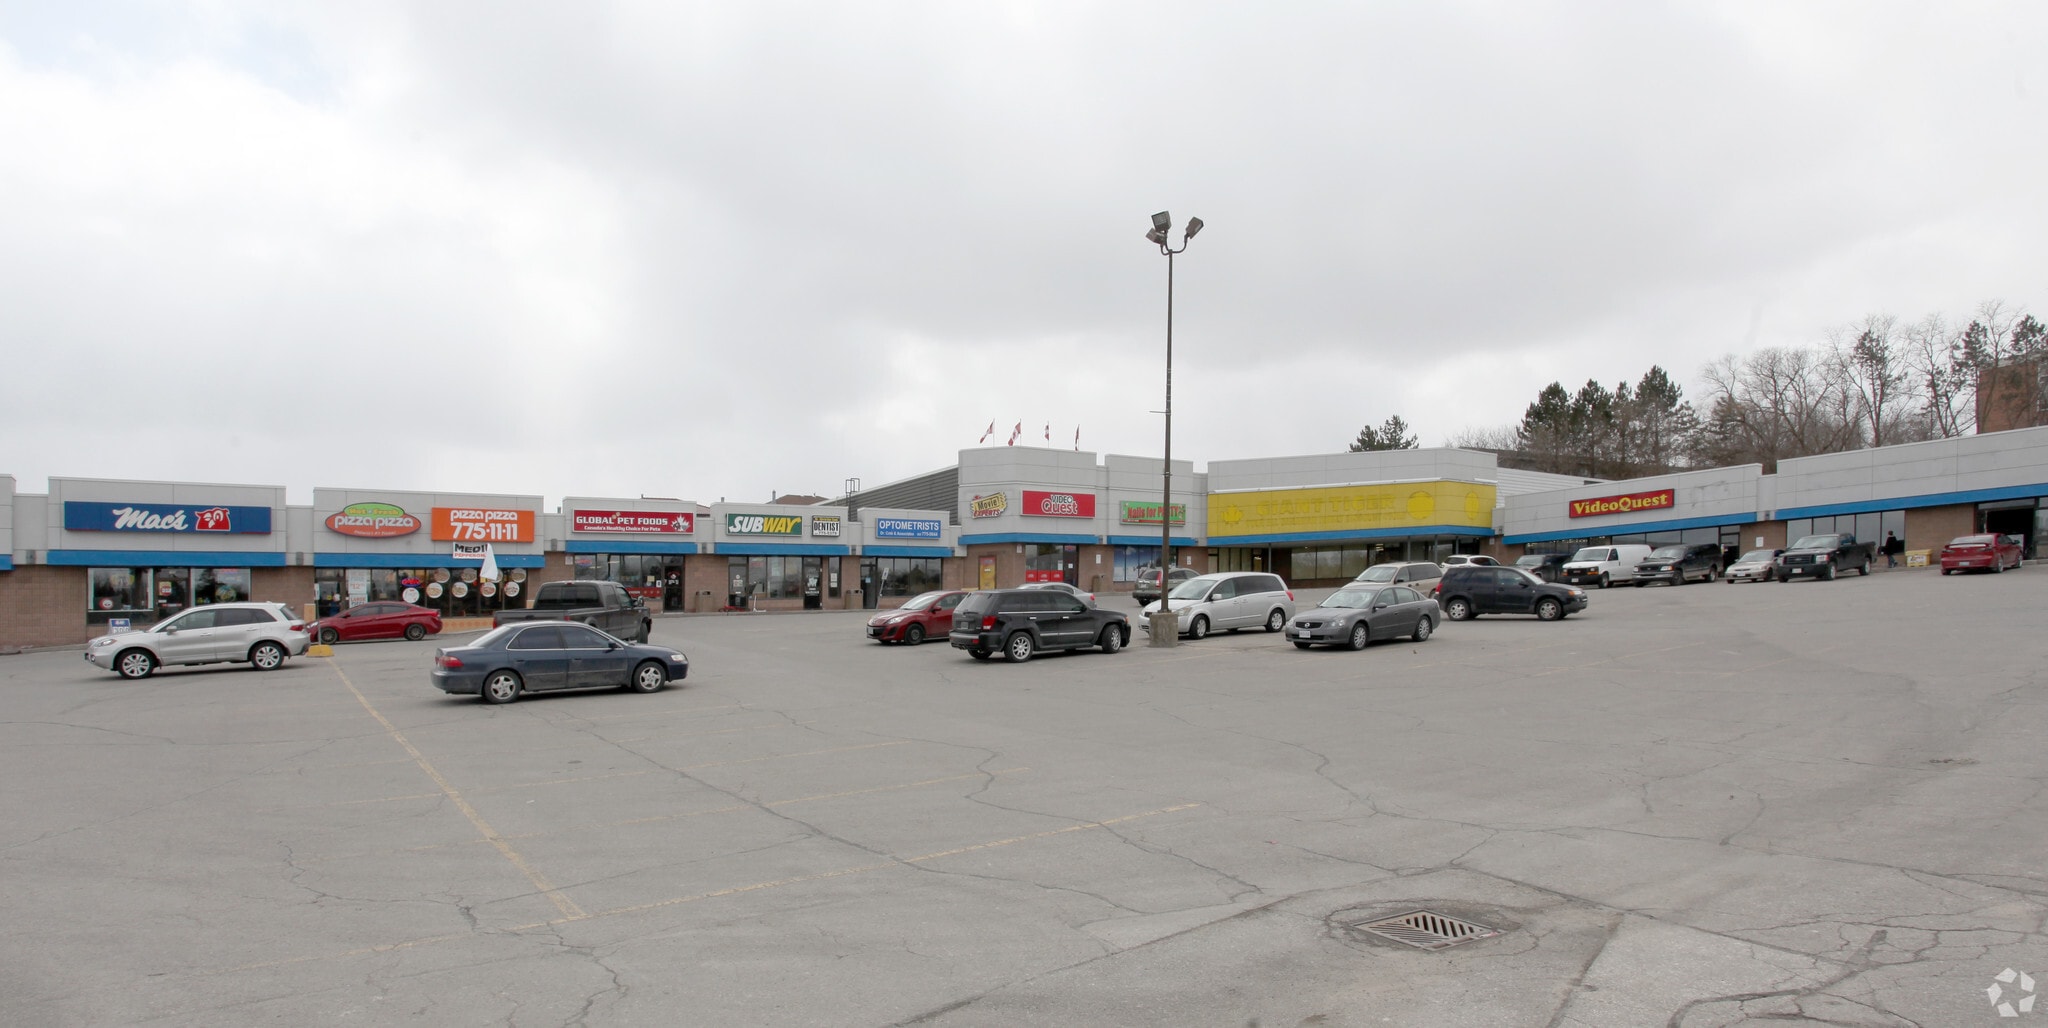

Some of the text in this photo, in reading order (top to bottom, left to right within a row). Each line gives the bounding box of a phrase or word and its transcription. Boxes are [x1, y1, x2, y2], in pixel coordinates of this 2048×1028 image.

[977, 496, 998, 511] Movie
[1041, 498, 1078, 514] Quest
[1051, 494, 1073, 504] VIDEO
[1573, 494, 1668, 514] VideoQuest
[450, 510, 518, 523] pizza pizza
[1127, 504, 1179, 518] Nails for PTY
[112, 507, 188, 530] Mac's
[334, 515, 414, 530] pizza pizza
[576, 516, 668, 526] GLOBAL PET FOODS
[728, 516, 802, 533] SUBWAY
[879, 520, 940, 531] OPTOMETRISTS
[813, 522, 839, 531] DENTIST
